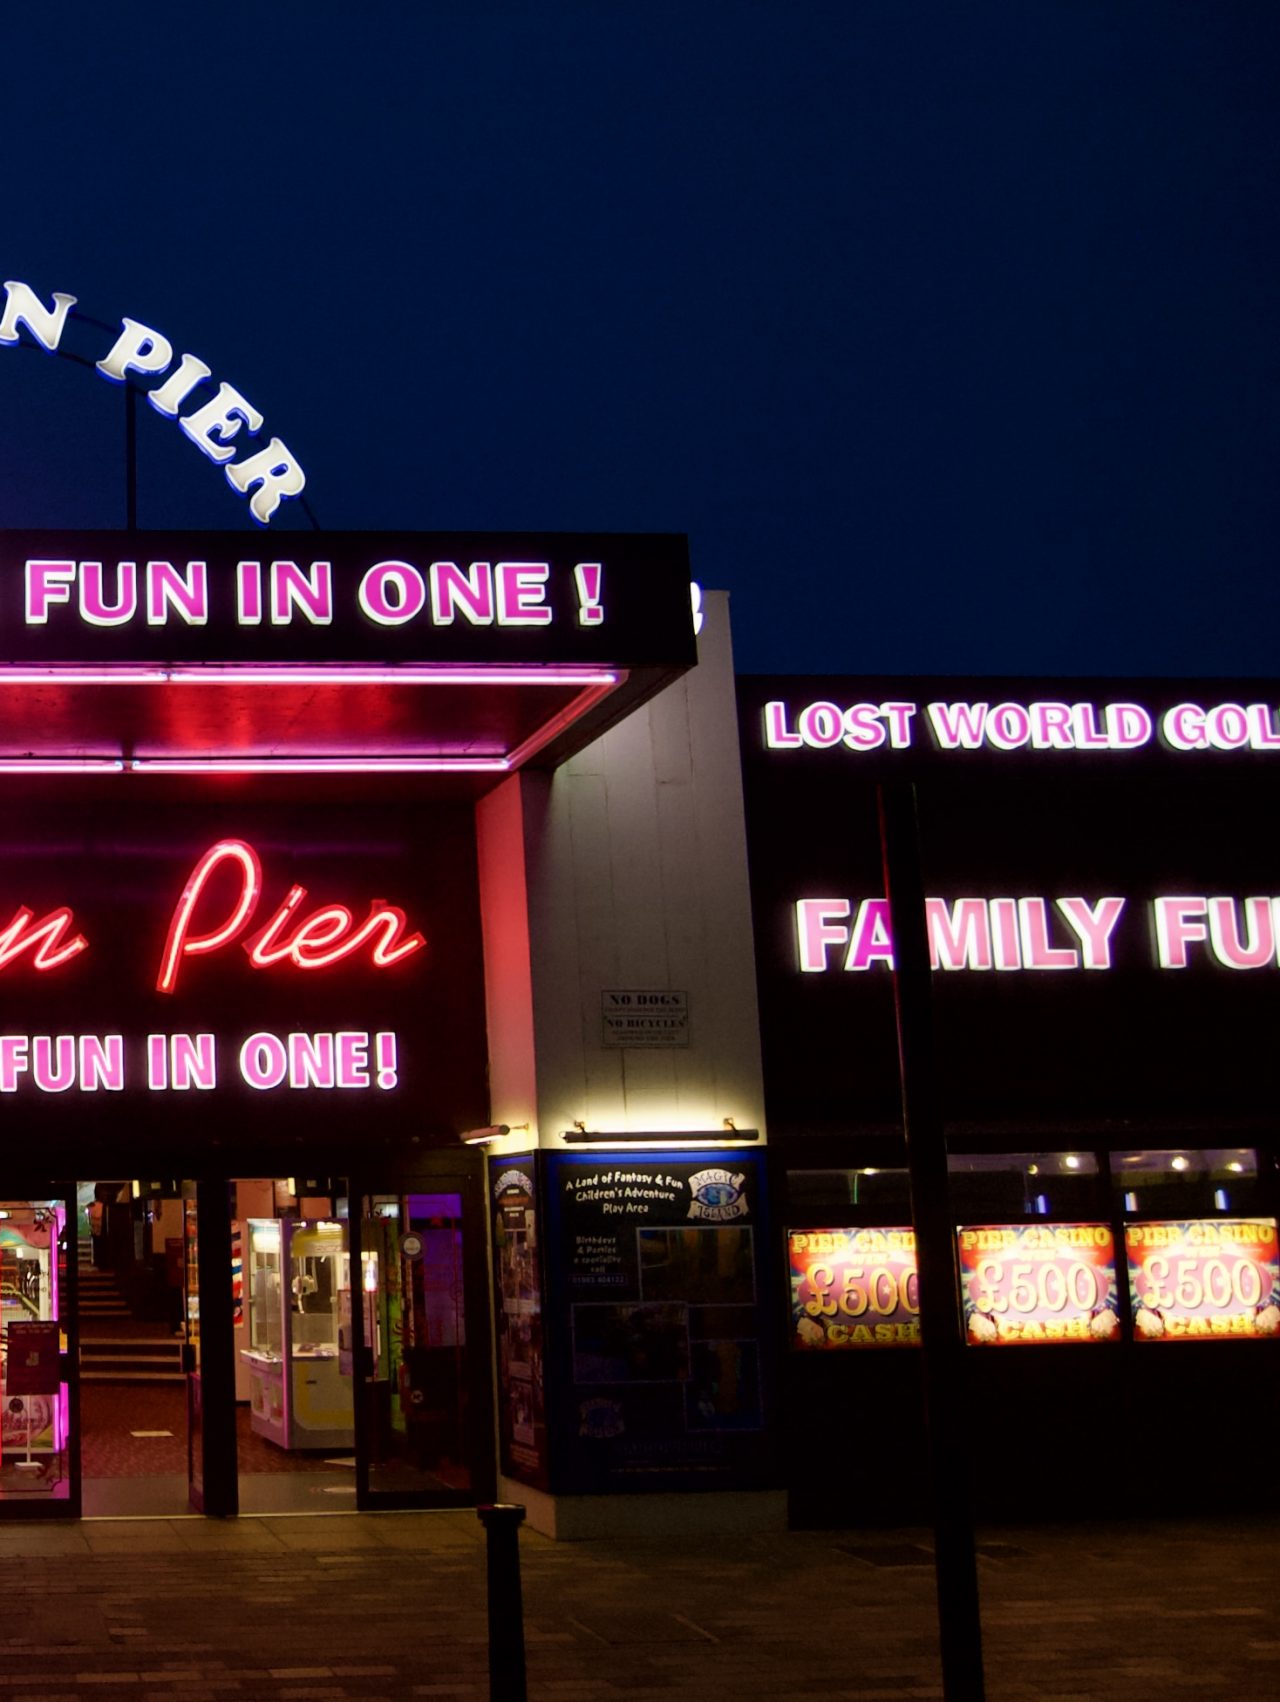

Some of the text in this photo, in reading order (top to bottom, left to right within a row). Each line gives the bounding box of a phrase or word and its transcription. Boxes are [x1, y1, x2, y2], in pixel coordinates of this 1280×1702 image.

[96, 318, 306, 526] PIER
[25, 560, 207, 626] FUN
[236, 560, 332, 626] IN
[765, 701, 1280, 752] LOST WORLD GOL
[156, 839, 426, 993] Pier
[796, 896, 1280, 973] FAMILY FU
[148, 1033, 216, 1091] IN
[240, 1031, 398, 1090] ONE!
[565, 1171, 684, 1191] A Land of Fantasy & Fun
[575, 1186, 676, 1202] Children's Adventure
[602, 1202, 648, 1214] Play Area
[792, 1232, 850, 1253] PIER
[963, 1226, 1110, 1251] PIER CASINO
[1127, 1223, 1275, 1247] PIER CASINO
[805, 1262, 920, 1317] £500
[975, 1259, 1098, 1314] £500
[1142, 1256, 1264, 1309] £500
[827, 1322, 920, 1344] CASH
[997, 1317, 1091, 1340] CASH
[1164, 1315, 1256, 1335] CASH
